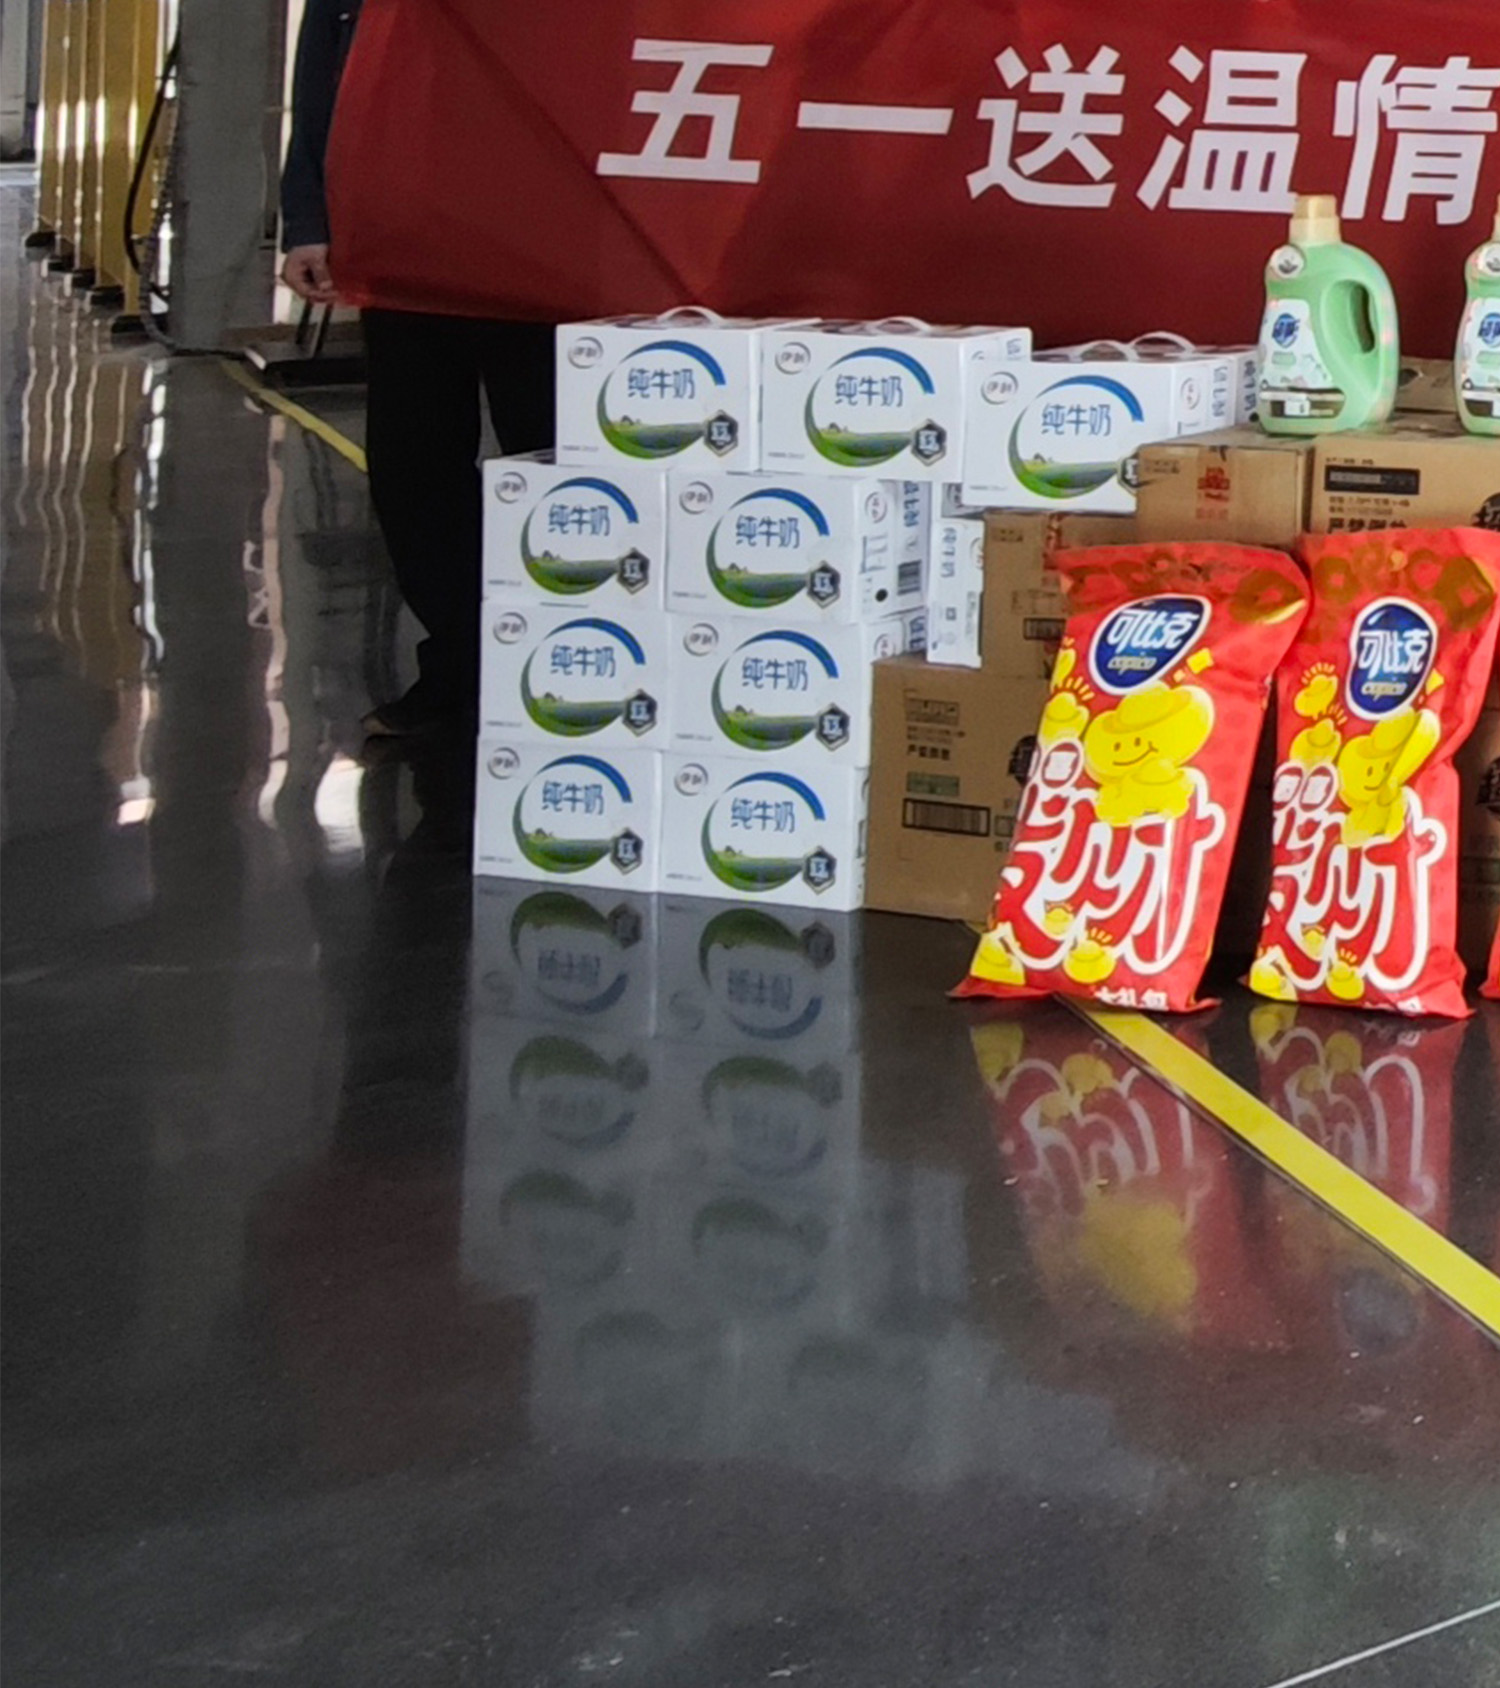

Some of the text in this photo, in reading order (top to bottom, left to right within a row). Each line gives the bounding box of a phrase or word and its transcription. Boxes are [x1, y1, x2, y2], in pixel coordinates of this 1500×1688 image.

[627, 367, 695, 401] 纯牛奶
[834, 374, 904, 409] 纯牛奶
[1040, 402, 1113, 438] 纯牛奶
[547, 503, 611, 538] 纯牛奶
[735, 514, 800, 549] 纯牛奶
[1105, 608, 1199, 652] 可比克
[550, 644, 617, 679] 纯牛奶
[1356, 630, 1428, 675] 可比克
[741, 657, 809, 691] 纯牛奶
[541, 779, 604, 816] 纯牛奶
[730, 797, 796, 834] 纯牛奶
